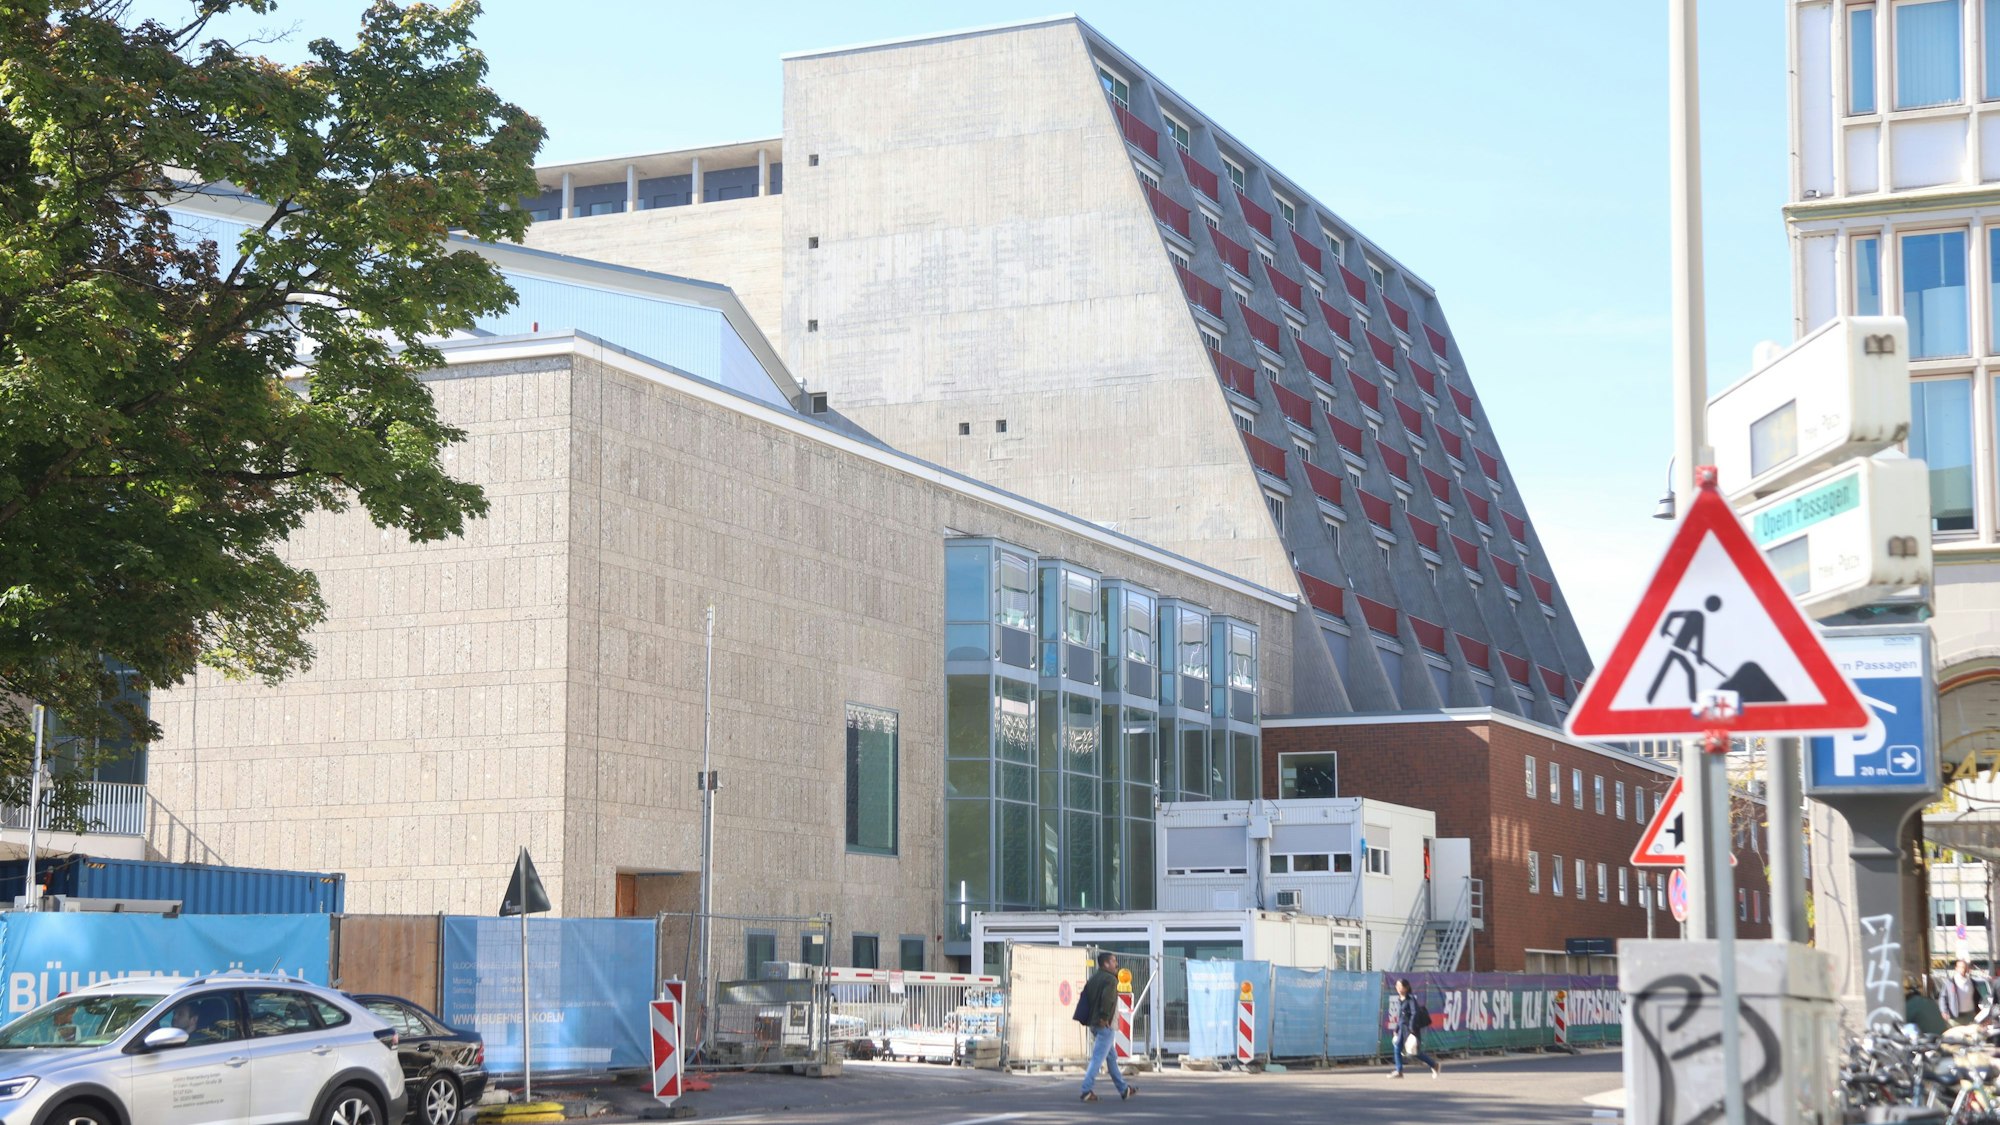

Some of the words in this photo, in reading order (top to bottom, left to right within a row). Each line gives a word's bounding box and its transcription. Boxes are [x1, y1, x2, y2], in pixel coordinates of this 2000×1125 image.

[1762, 509, 1792, 540] Opern
[1796, 486, 1850, 523] Passagen
[1855, 660, 1918, 672] Passagen
[1833, 711, 1887, 777] P
[453, 1012, 565, 1025] WWW.BUEHNE.KOELN
[1466, 989, 1488, 1031] DAS
[1546, 990, 1559, 1027] IS
